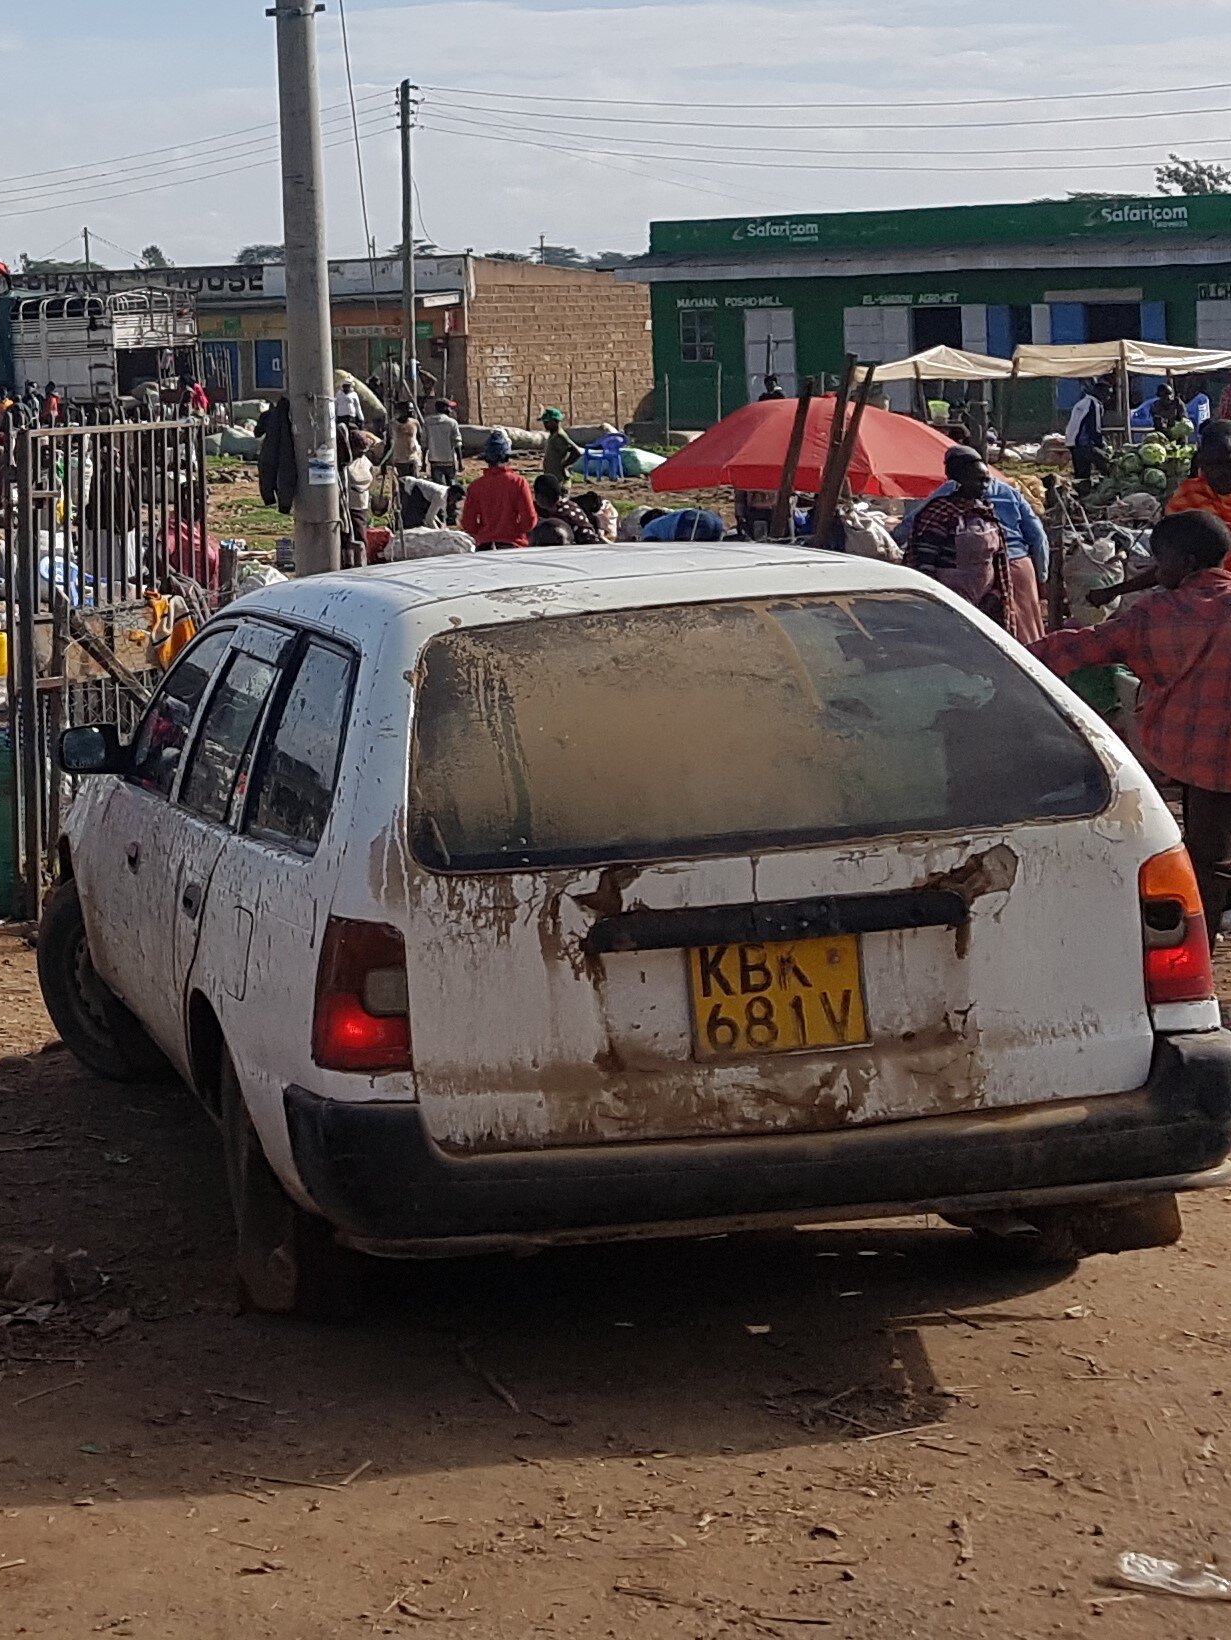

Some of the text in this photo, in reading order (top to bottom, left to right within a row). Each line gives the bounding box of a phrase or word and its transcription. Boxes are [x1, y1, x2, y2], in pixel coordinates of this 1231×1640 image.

[1101, 203, 1188, 222] Safaricom
[747, 221, 818, 237] Safaricom
[166, 266, 264, 292] HOUSE
[699, 942, 813, 998] KBK
[706, 988, 853, 1051] 681V
